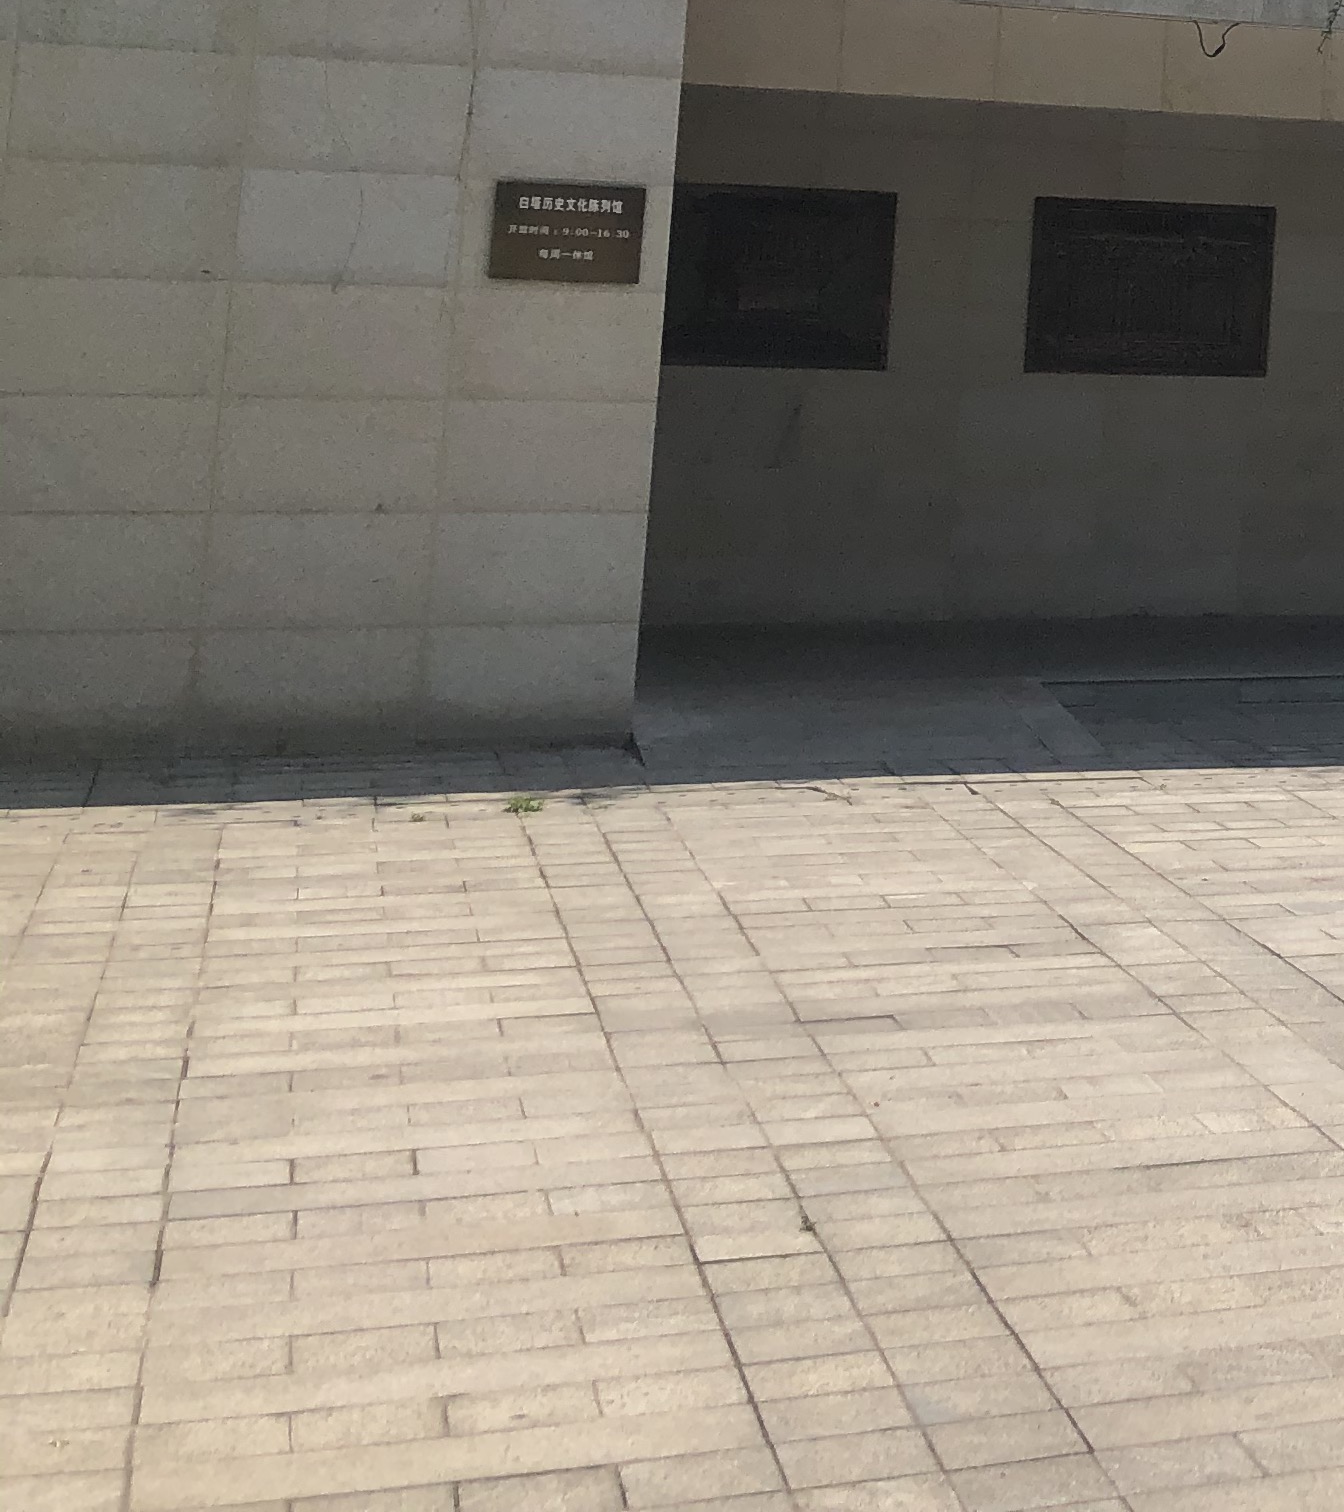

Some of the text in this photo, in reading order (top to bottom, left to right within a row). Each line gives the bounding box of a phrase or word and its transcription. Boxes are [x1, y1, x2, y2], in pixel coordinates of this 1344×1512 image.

[519, 196, 623, 214] 白塔历史文化陈列馆
